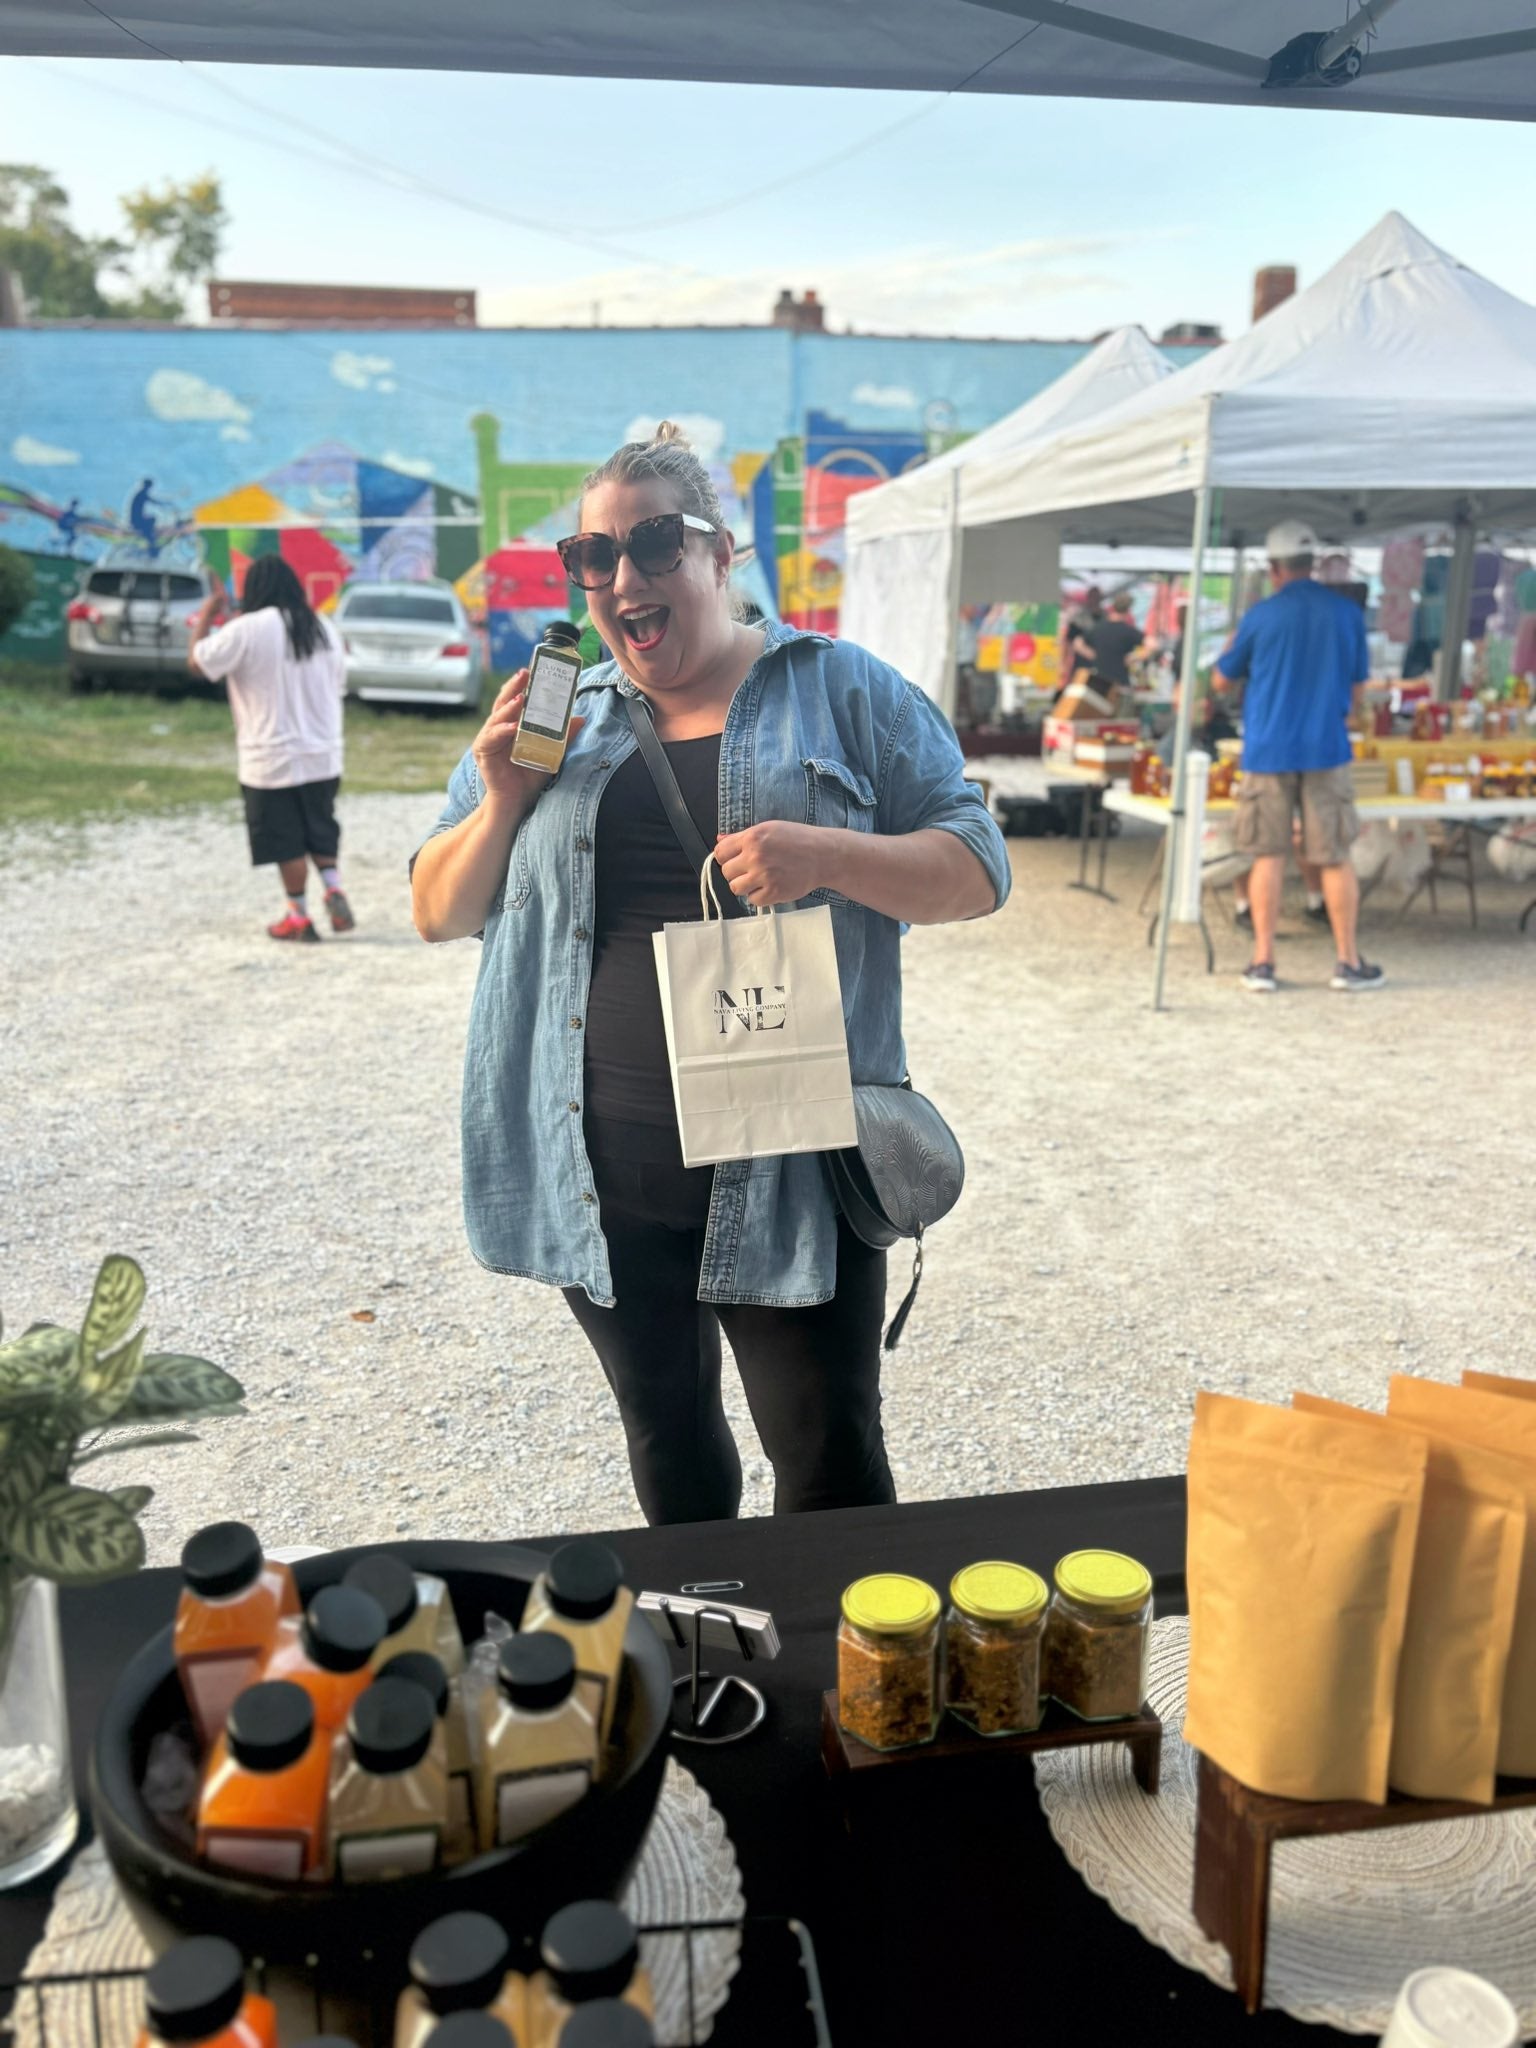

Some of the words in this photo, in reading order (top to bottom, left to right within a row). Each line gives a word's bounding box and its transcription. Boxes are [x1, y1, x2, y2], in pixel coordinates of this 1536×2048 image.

[537, 668, 572, 682] CLEANSE
[545, 665, 568, 675] LUNG
[755, 1003, 786, 1012] COMPANY
